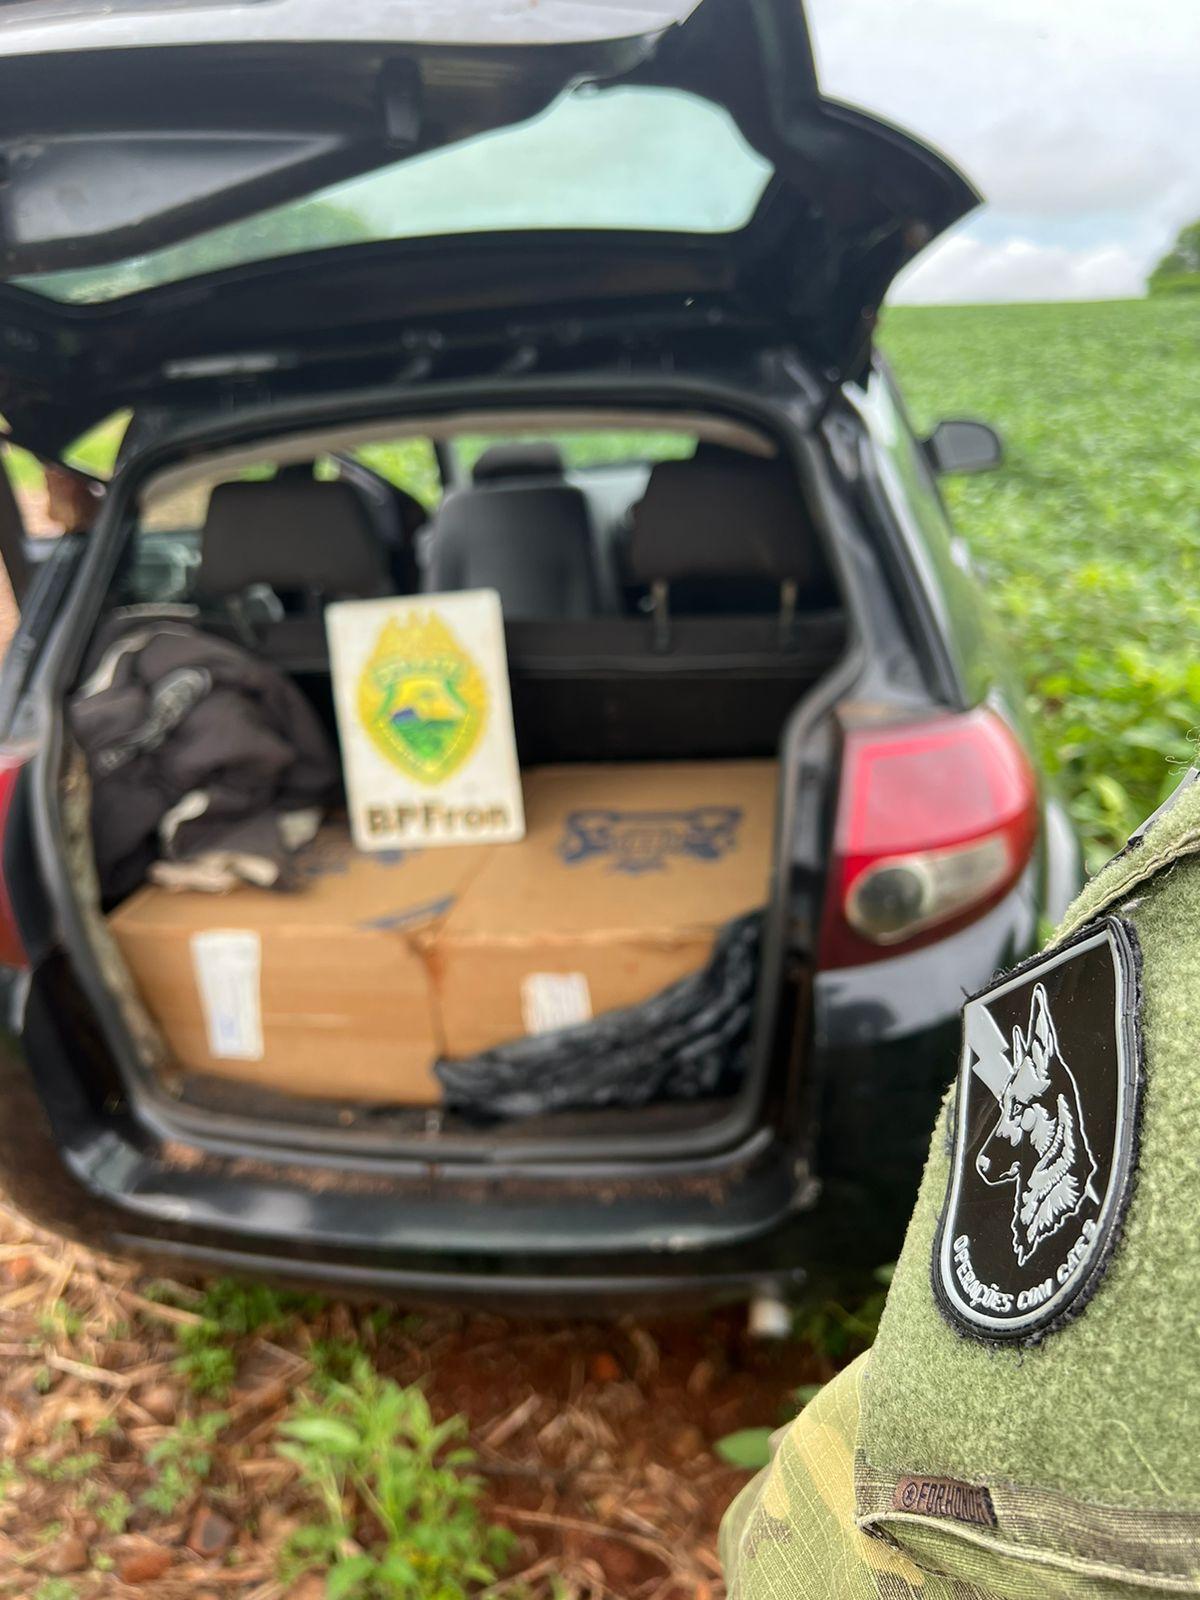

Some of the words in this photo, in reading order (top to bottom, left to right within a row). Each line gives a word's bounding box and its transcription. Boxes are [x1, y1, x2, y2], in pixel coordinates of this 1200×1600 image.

[367, 804, 508, 836] BPFron
[953, 1234, 1014, 1312] OPERAÇÕES
[1017, 1277, 1054, 1310] COM
